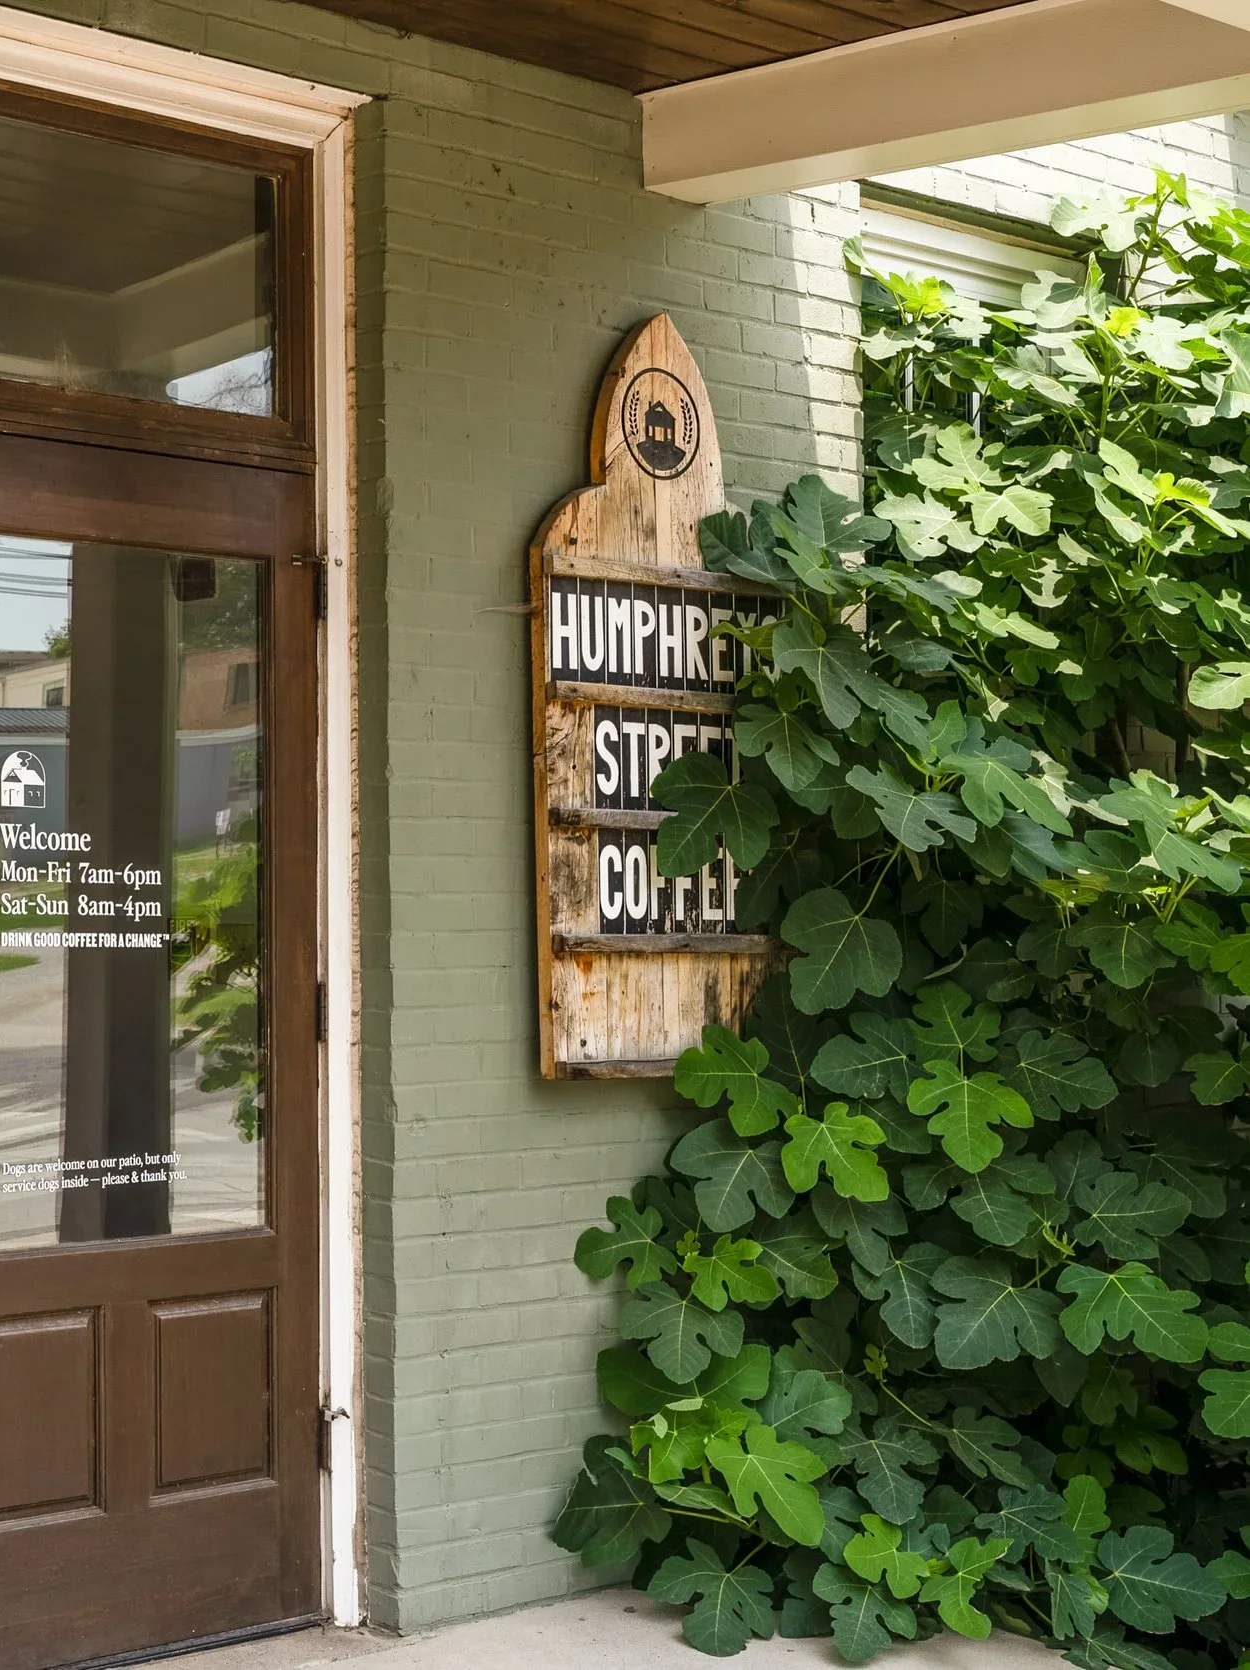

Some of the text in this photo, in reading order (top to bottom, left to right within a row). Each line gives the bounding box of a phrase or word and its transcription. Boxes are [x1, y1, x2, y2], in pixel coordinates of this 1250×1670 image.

[1, 860, 162, 890] Mon-Fri 7am-6pm
[1, 893, 162, 921] Sat-Sun 8am-4pm
[1, 932, 33, 947] DRINK
[34, 933, 61, 947] GOOD
[62, 933, 97, 947] COFFEE
[99, 933, 117, 948] FOR
[118, 933, 125, 948] A
[3, 1151, 181, 1177] Dogs are welcome on our patio, but only
[2, 1181, 37, 1193] service
[38, 1178, 60, 1193] dogs
[61, 1174, 89, 1188] inside
[102, 1173, 129, 1188] please
[131, 1172, 139, 1183] &
[141, 1169, 167, 1182] thank
[169, 1170, 187, 1182] you.
